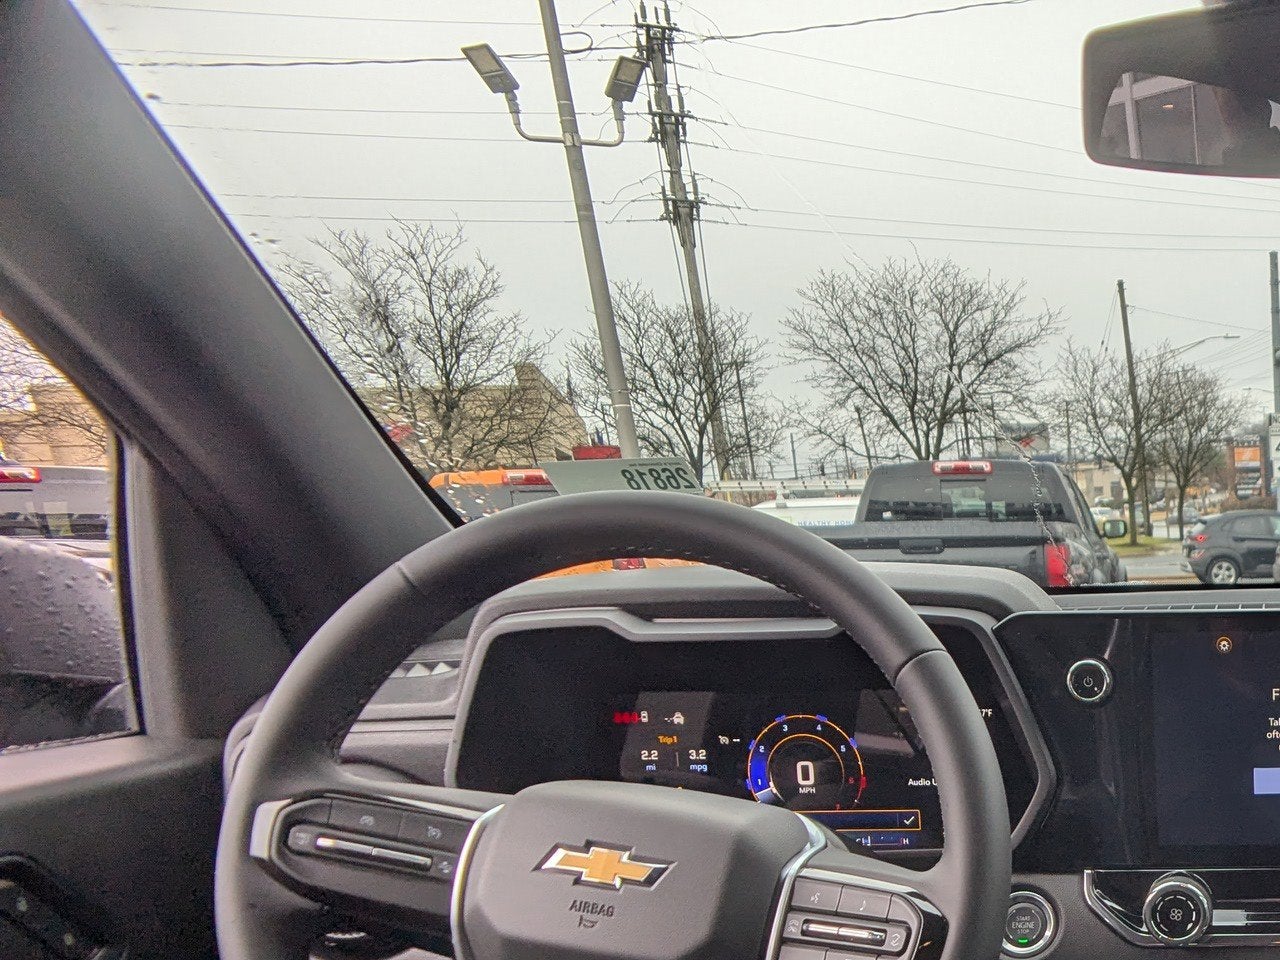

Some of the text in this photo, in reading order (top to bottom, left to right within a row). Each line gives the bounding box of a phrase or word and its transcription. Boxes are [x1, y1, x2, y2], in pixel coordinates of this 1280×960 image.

[641, 750, 658, 760] 2.2
[688, 750, 706, 760] 3.2
[796, 761, 814, 785] 0
[569, 900, 615, 918] AIRBAG
